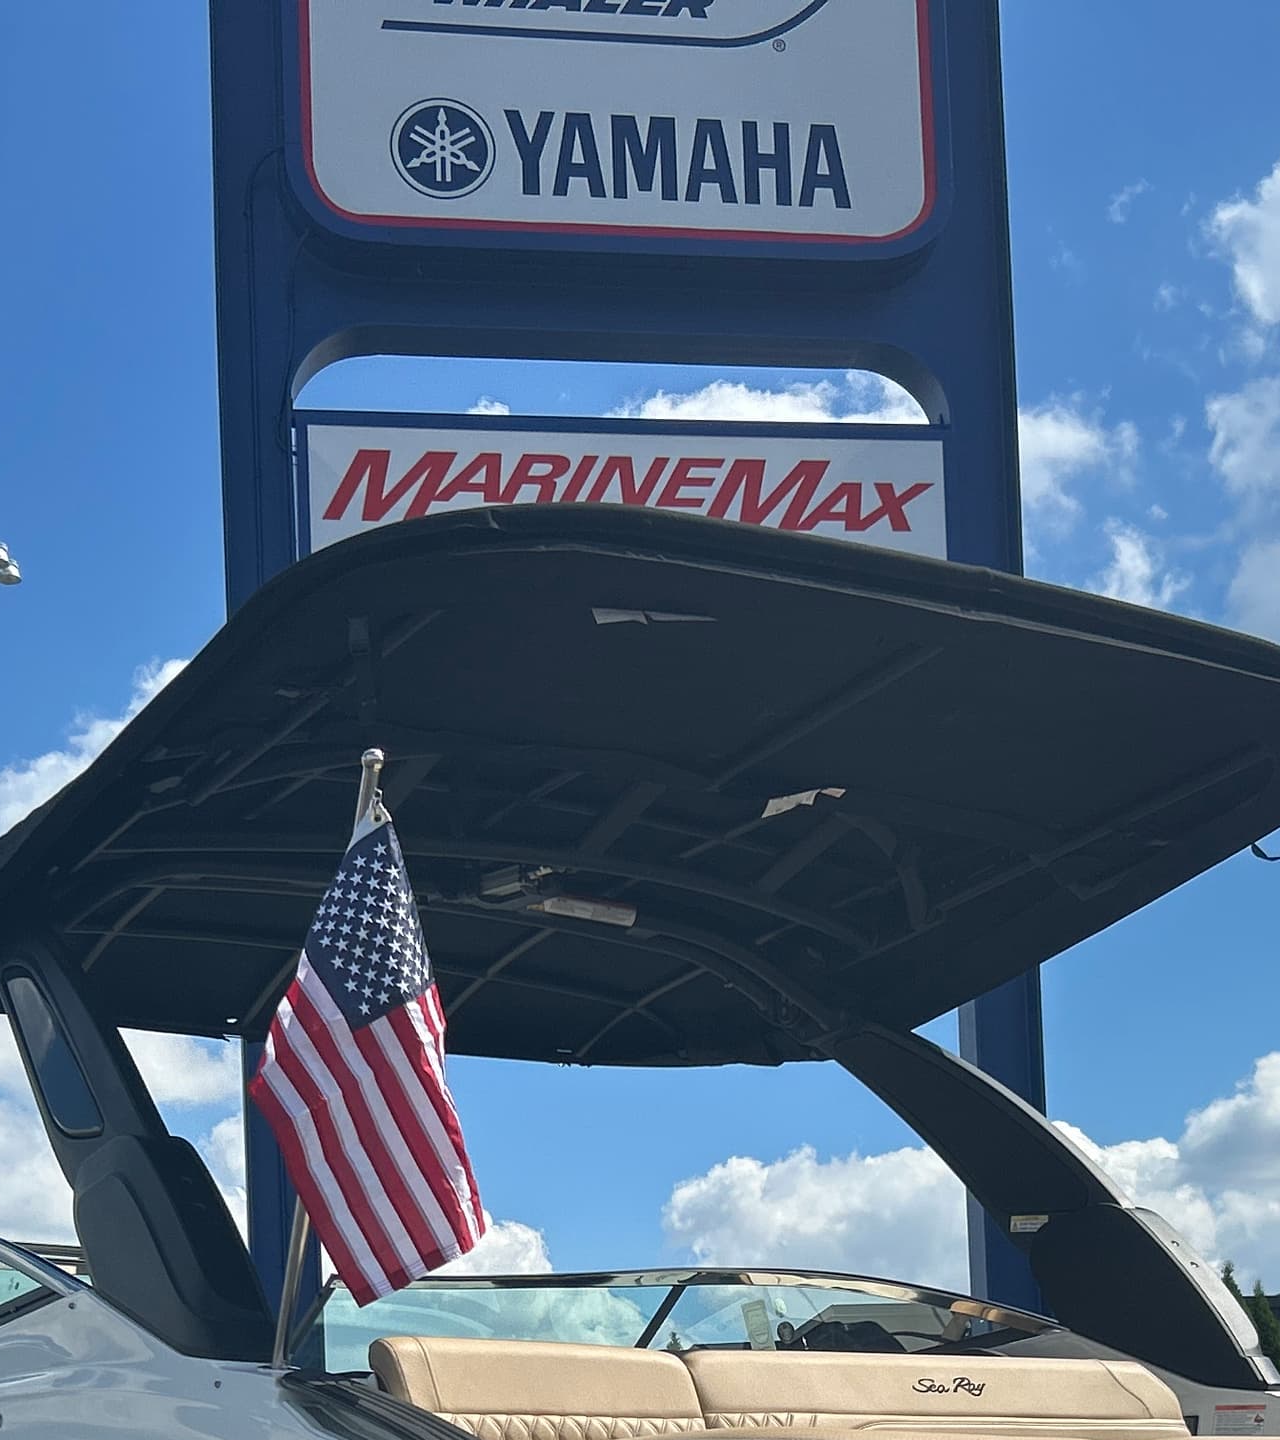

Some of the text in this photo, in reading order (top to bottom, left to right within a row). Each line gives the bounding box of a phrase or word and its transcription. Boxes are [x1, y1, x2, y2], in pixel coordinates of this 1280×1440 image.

[504, 109, 851, 209] YAMAHA
[912, 1377, 986, 1397] Sea Ray
